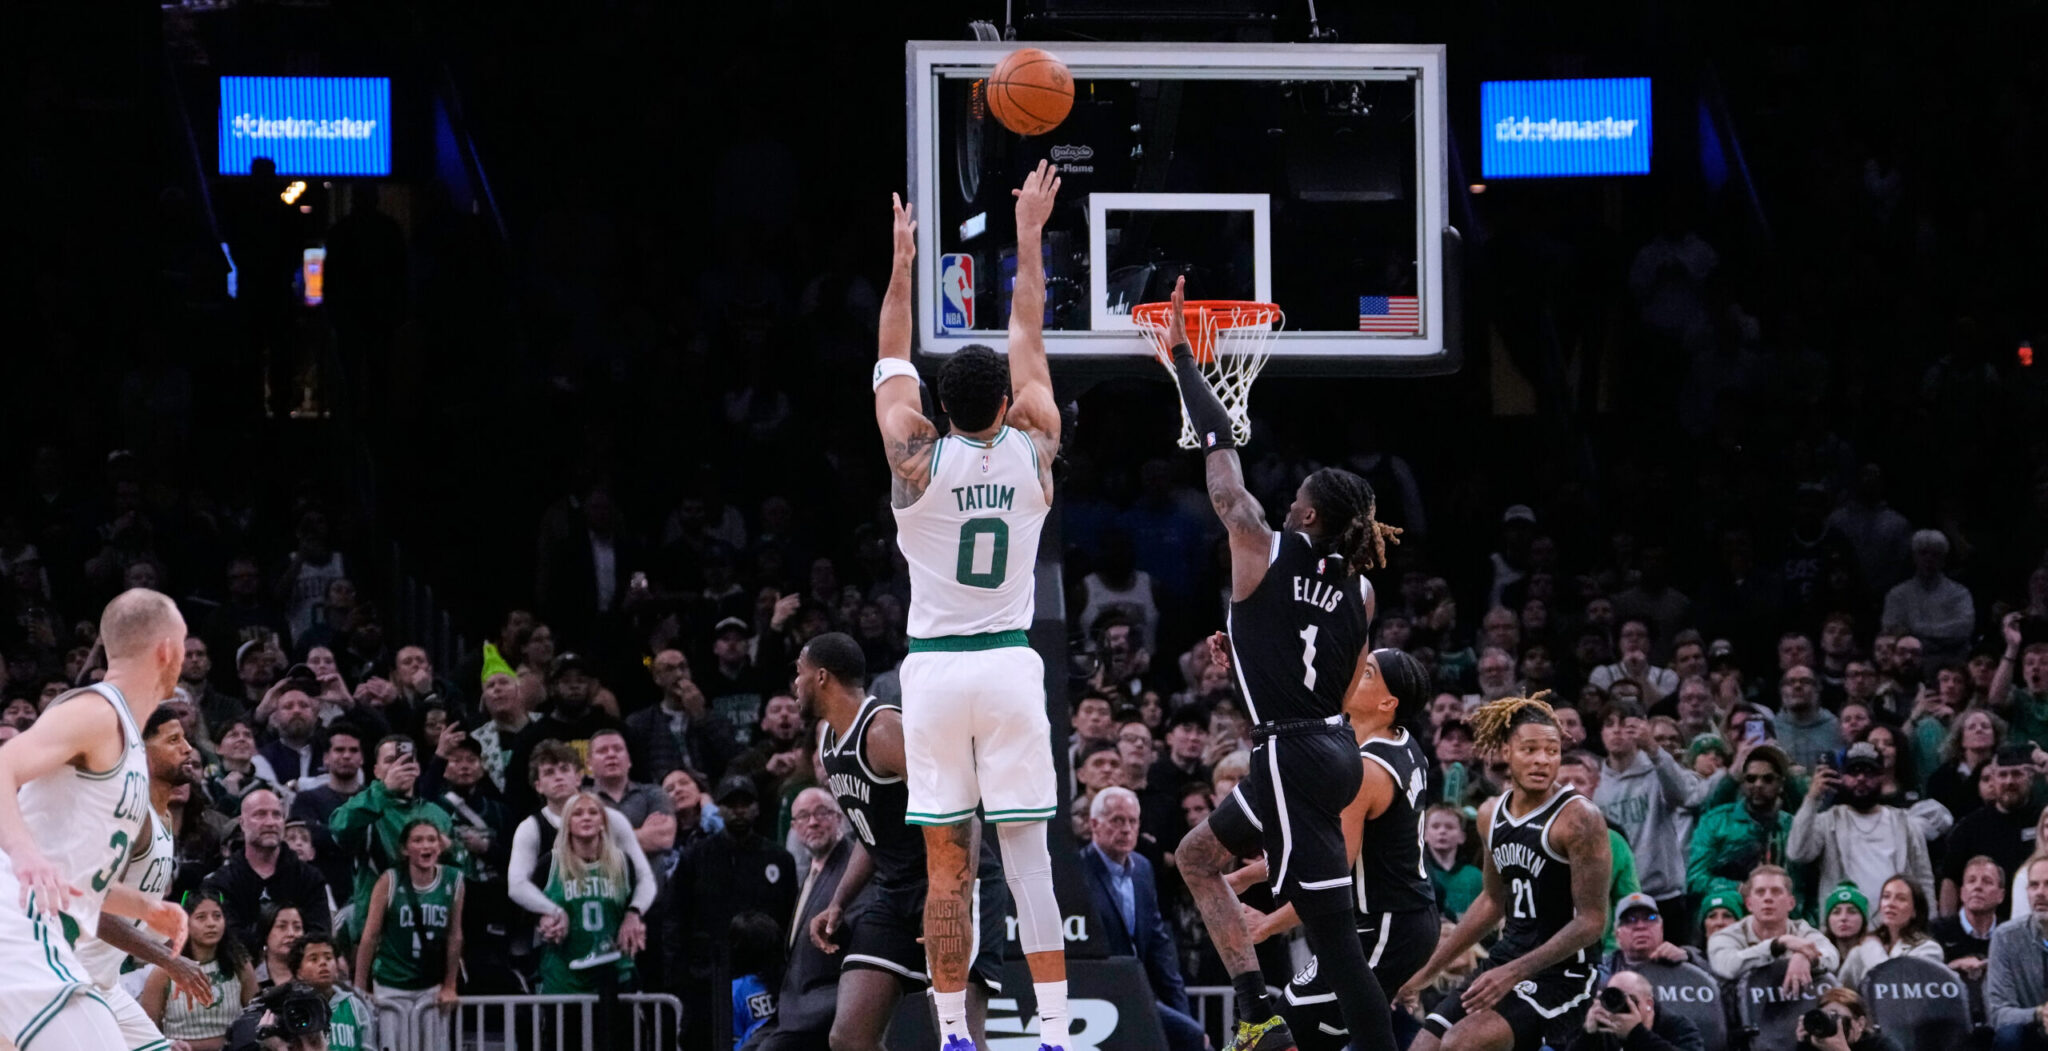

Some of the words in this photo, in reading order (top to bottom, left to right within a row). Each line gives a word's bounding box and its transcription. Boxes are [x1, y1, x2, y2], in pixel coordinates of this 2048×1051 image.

[231, 113, 376, 139] ticketmaster
[1496, 116, 1638, 141] ticketmaster
[945, 312, 961, 325] NBA
[951, 484, 1015, 511] TATUM
[956, 517, 1009, 589] 0
[1293, 575, 1343, 613] ELLIS
[1300, 624, 1318, 692] 1
[91, 830, 133, 893] 3
[1492, 842, 1547, 878] ROOKLYN
[1511, 878, 1537, 918] 21
[582, 901, 604, 932] 0
[1657, 985, 1714, 1002] MCO
[1874, 982, 1959, 999] PIMCO
[330, 1022, 355, 1048] TON
